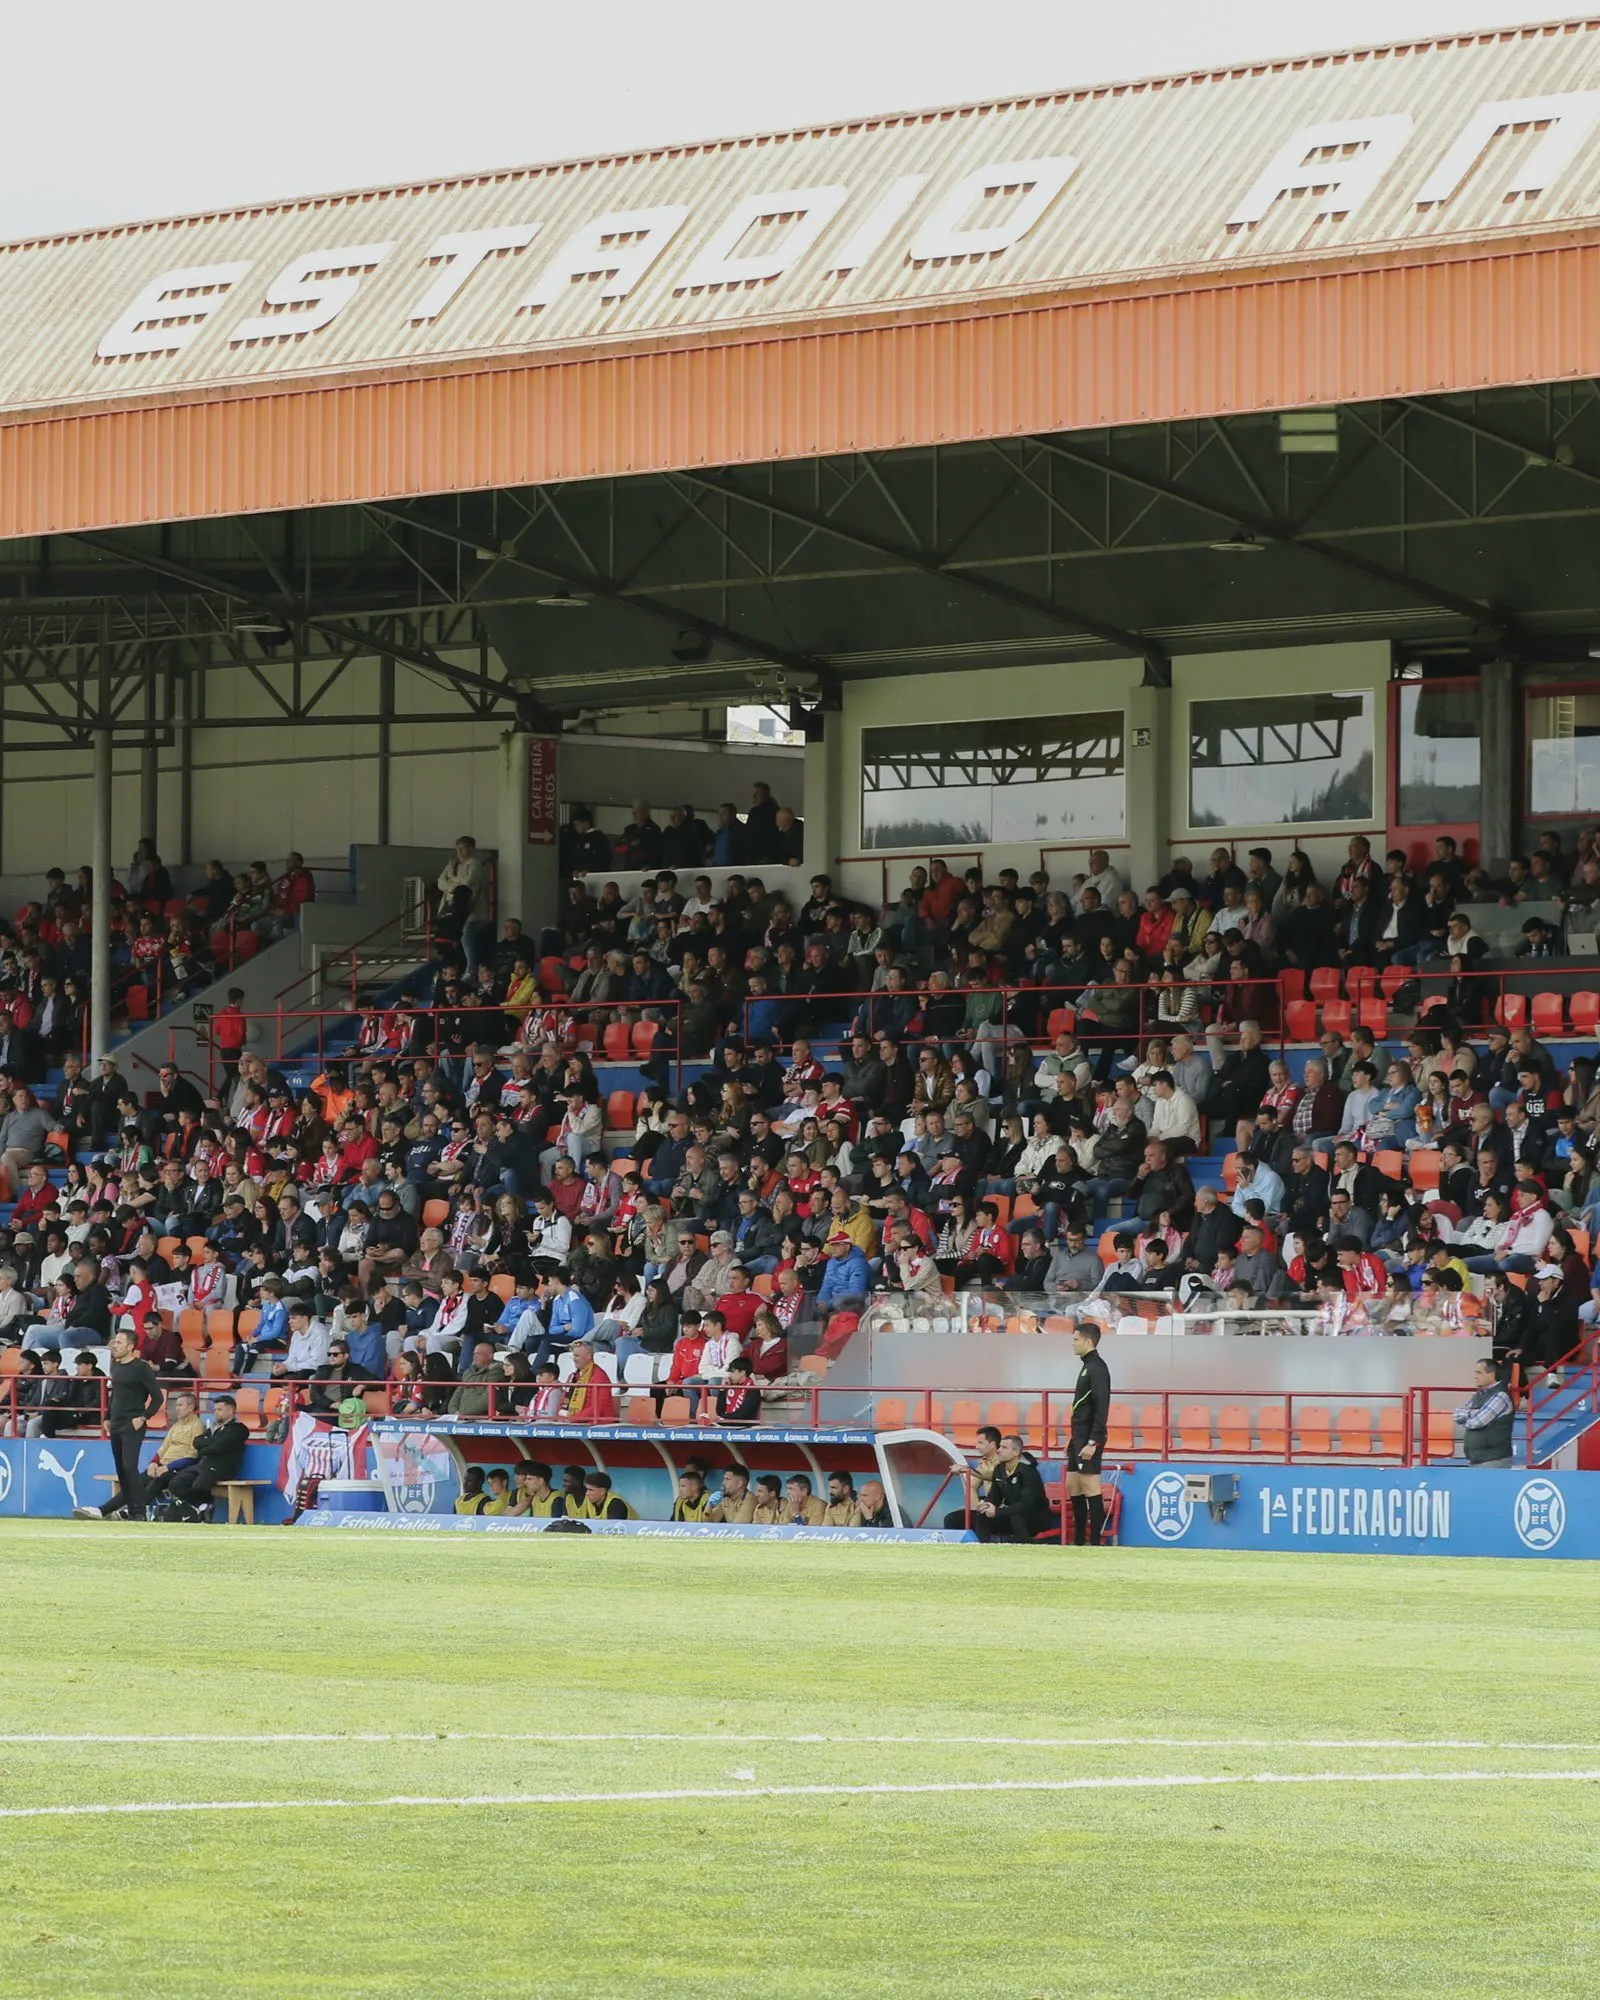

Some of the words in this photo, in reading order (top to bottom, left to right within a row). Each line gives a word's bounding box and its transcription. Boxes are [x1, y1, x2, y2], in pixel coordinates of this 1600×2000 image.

[97, 154, 1079, 358] ESTADIO
[530, 741, 543, 819] CAFETERÍA
[545, 774, 555, 820] ASEOS
[1161, 1496, 1178, 1505] RF
[1531, 1503, 1549, 1513] RF
[1161, 1507, 1178, 1516] EF
[1292, 1482, 1450, 1538] FEDERACIÓN
[337, 1515, 389, 1529] Estrella
[391, 1517, 441, 1531] Galicia
[1531, 1515, 1549, 1525] EF
